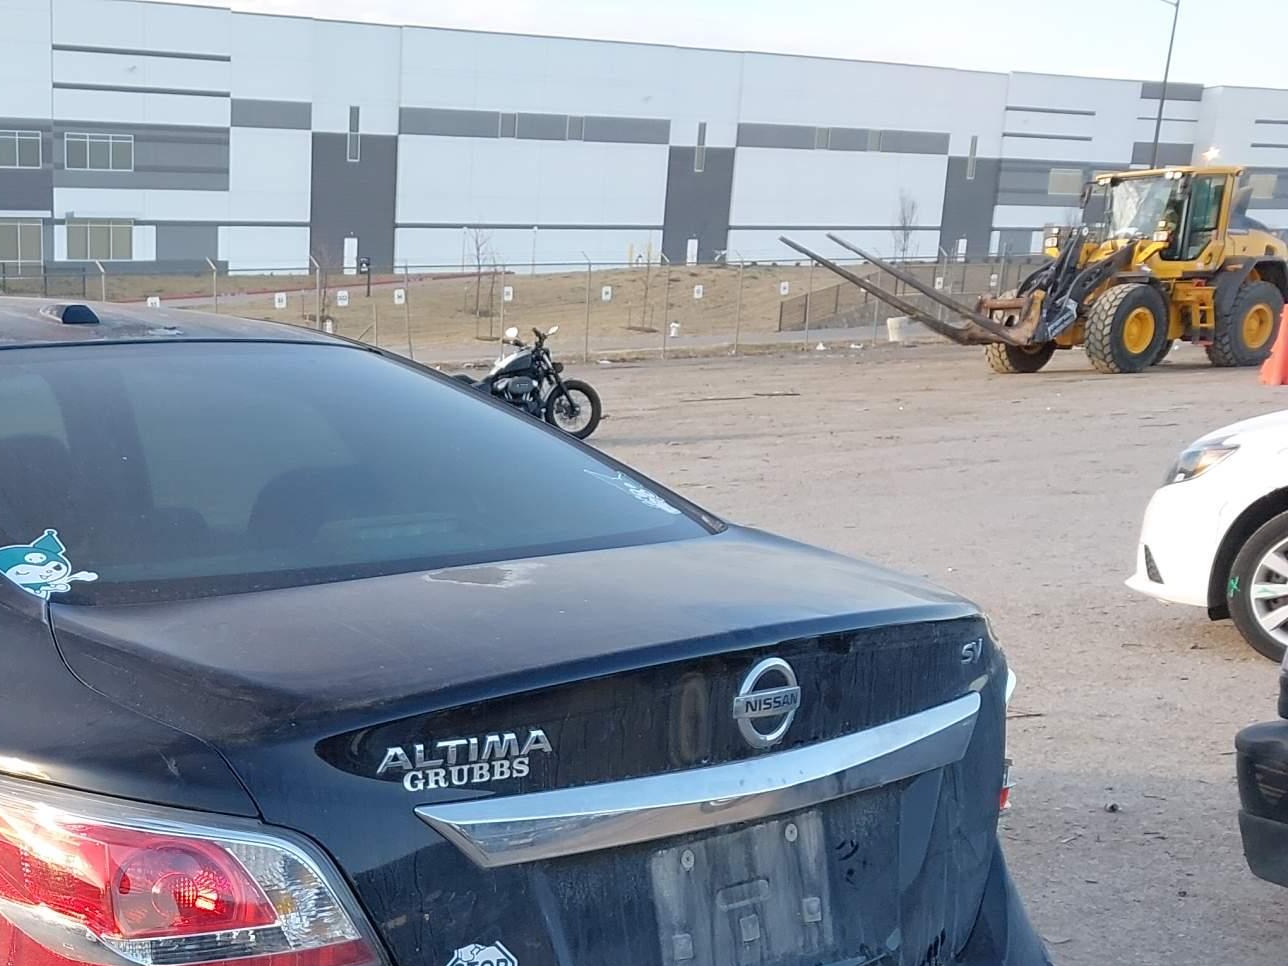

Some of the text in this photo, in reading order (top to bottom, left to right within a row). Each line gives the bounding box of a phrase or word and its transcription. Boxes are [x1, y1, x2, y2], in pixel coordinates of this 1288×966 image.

[745, 692, 798, 713] NISSAN
[377, 729, 553, 775] ALTIMA
[403, 757, 530, 792] GRUBBS
